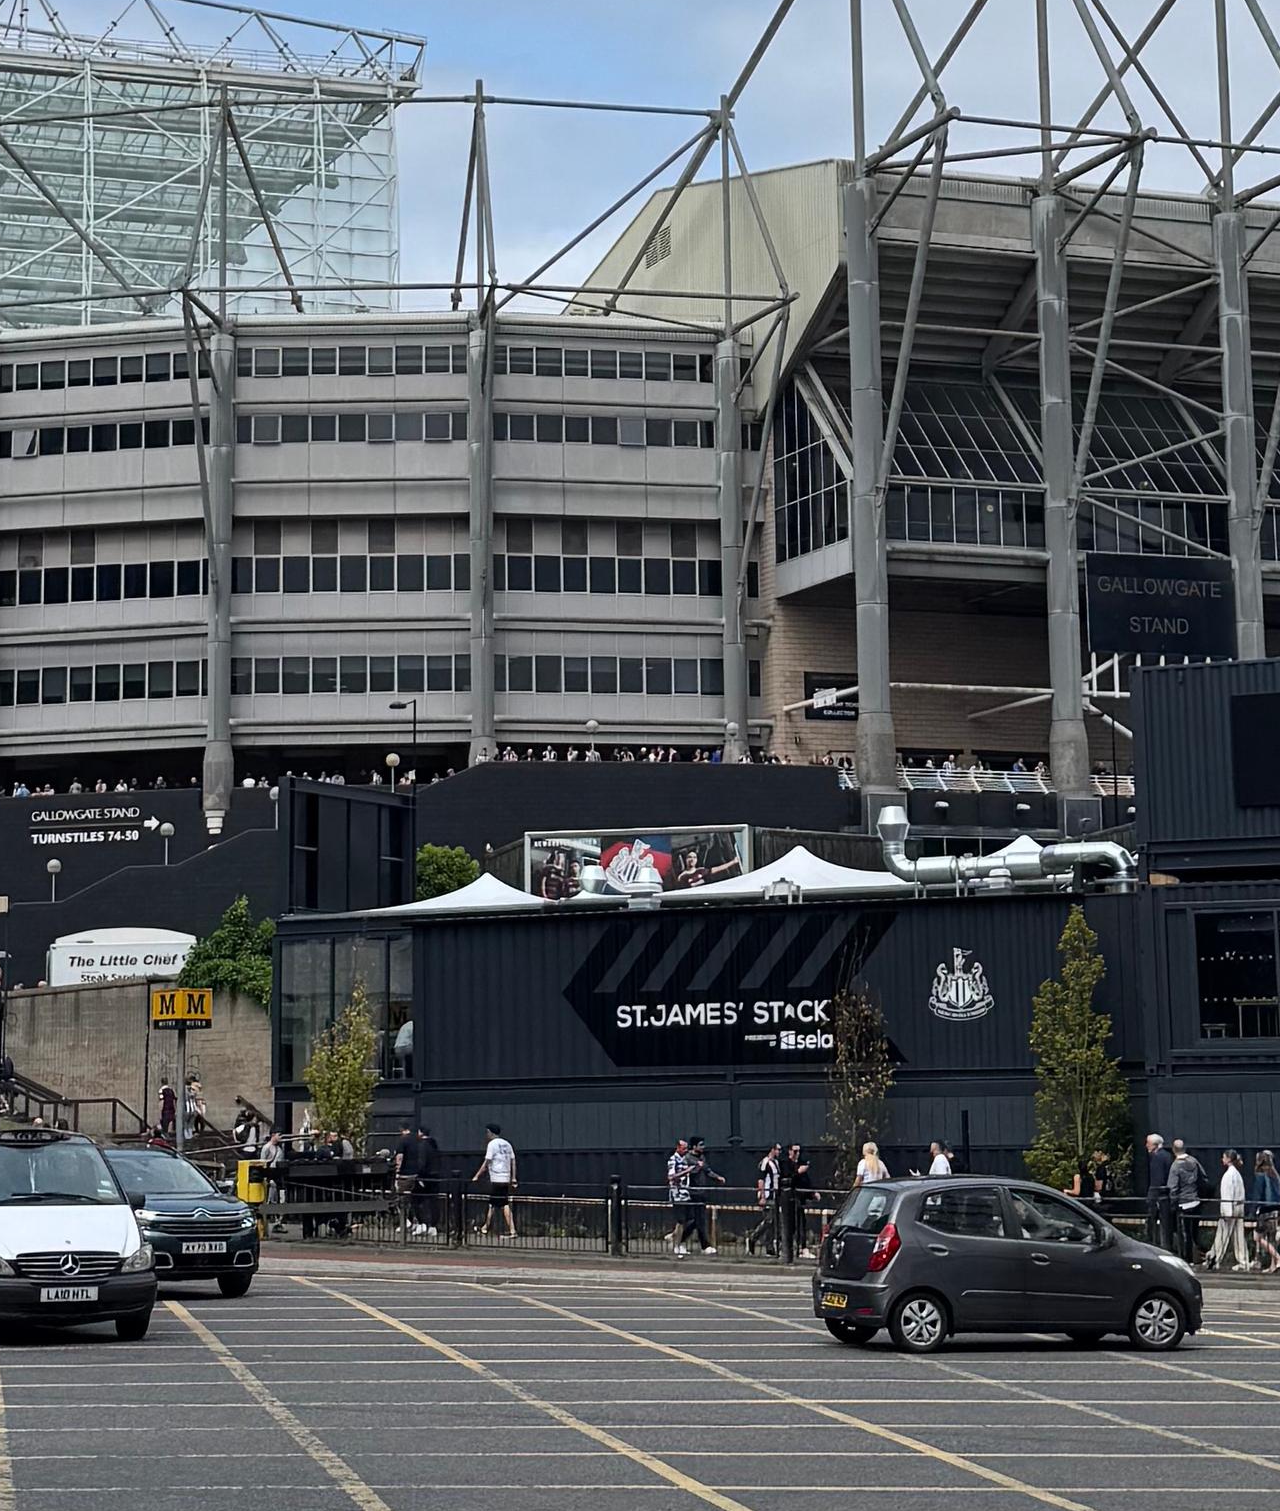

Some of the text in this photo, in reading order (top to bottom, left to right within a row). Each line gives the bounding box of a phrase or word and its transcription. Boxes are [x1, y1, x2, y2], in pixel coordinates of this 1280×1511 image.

[1097, 575, 1222, 598] GALLOWGATE
[1129, 616, 1189, 634] STAND
[31, 807, 140, 822] GALLOWGATE STAND
[31, 831, 105, 844] TURNSTILES
[69, 954, 178, 968] The Little Chef
[159, 994, 176, 1015] M
[187, 994, 205, 1014] M
[797, 1029, 833, 1049] sela
